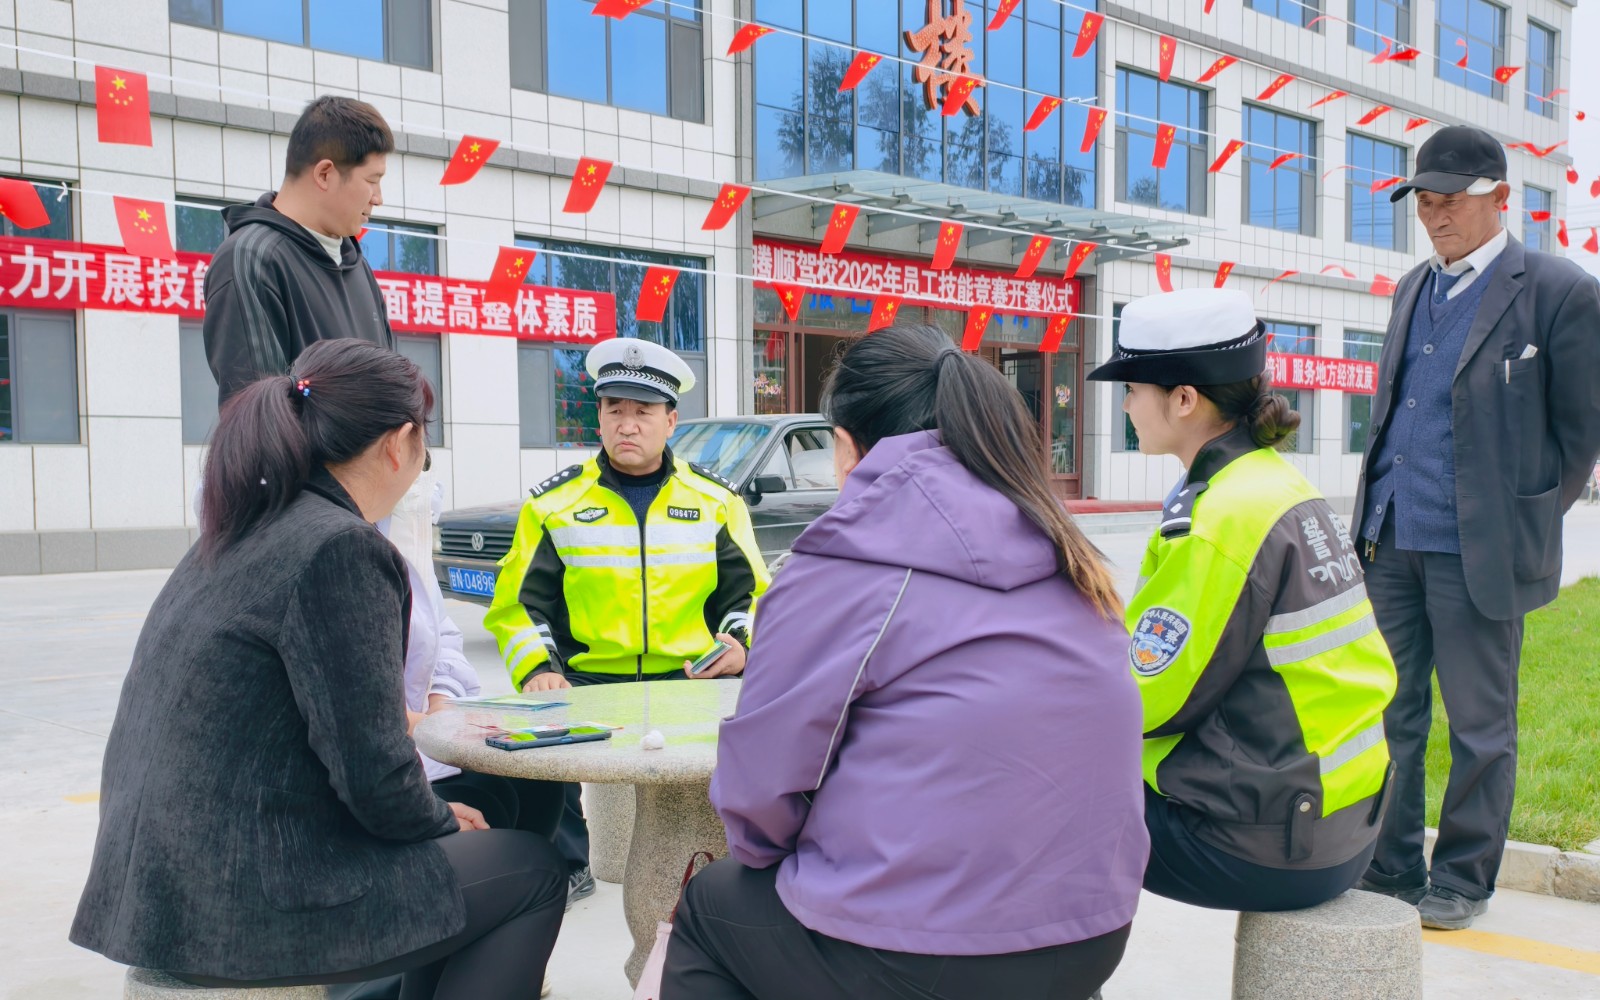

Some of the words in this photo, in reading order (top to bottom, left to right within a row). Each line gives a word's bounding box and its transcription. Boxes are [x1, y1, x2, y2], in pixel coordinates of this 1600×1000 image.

[0, 245, 210, 310] 力开展技
[376, 278, 598, 338] 面提高整体素质
[752, 244, 1074, 313] 腾顺驾校2025年员工技能竞赛开赛仪式
